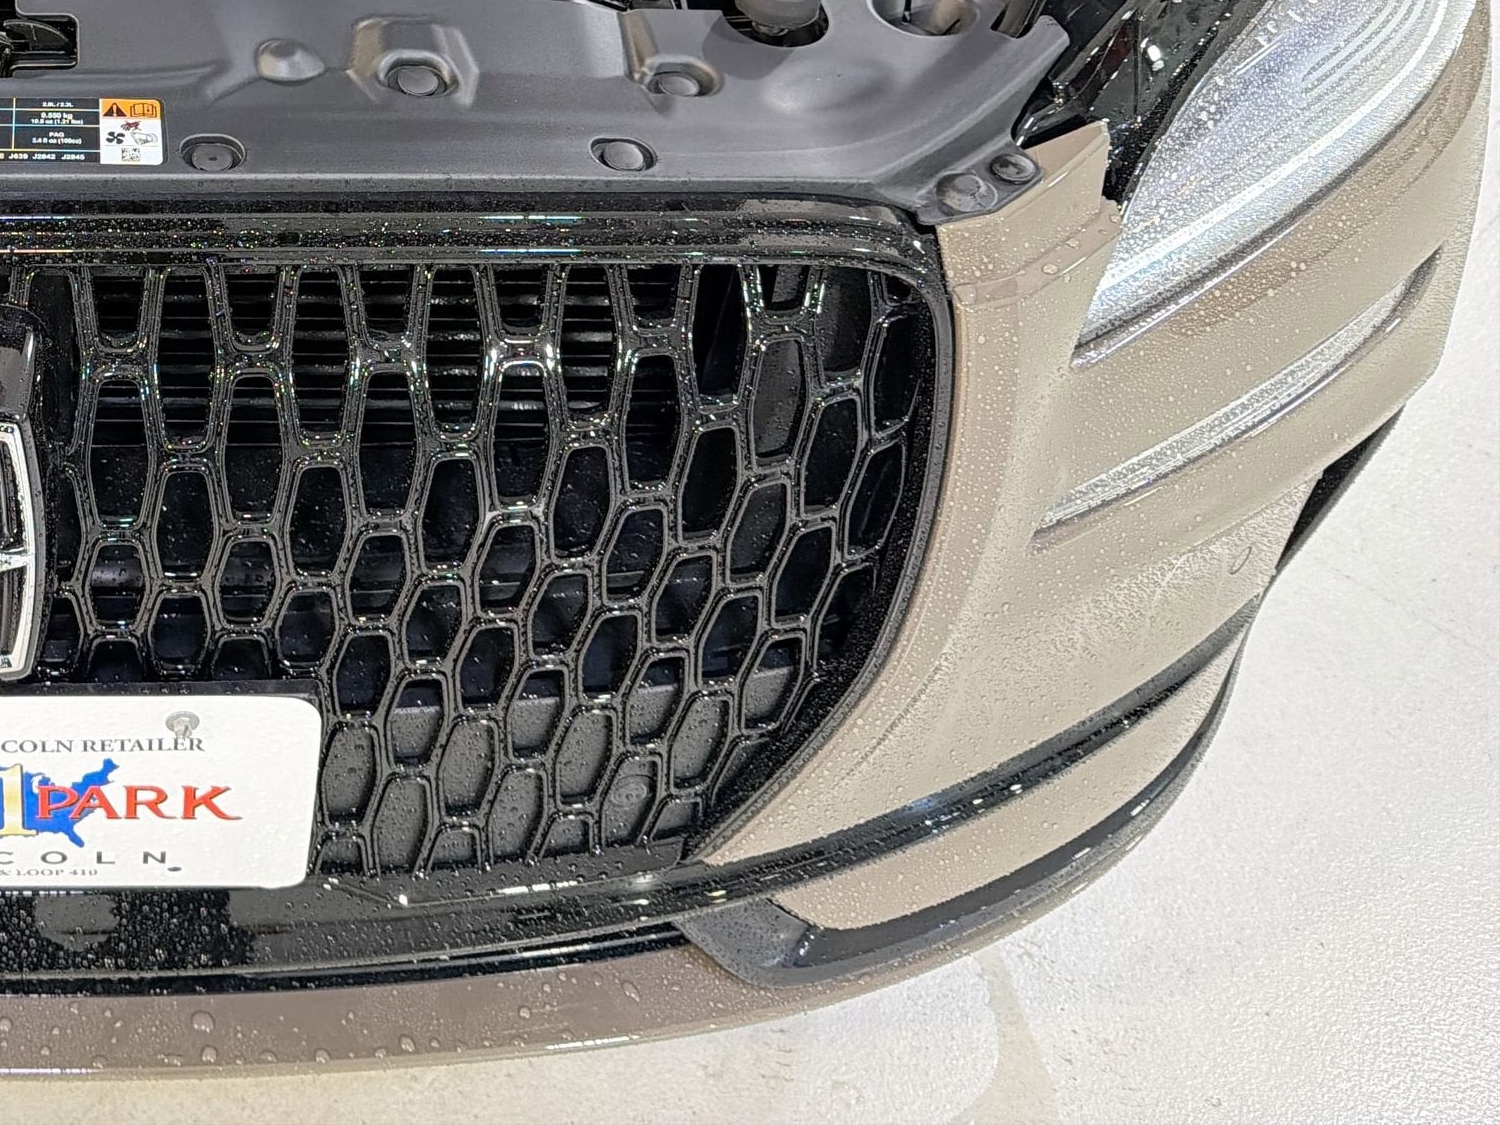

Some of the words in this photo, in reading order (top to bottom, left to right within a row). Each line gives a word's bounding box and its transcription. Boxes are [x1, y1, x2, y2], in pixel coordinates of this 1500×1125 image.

[63, 112, 74, 120] kg
[81, 737, 206, 753] RETAILER
[36, 785, 243, 820] PARK
